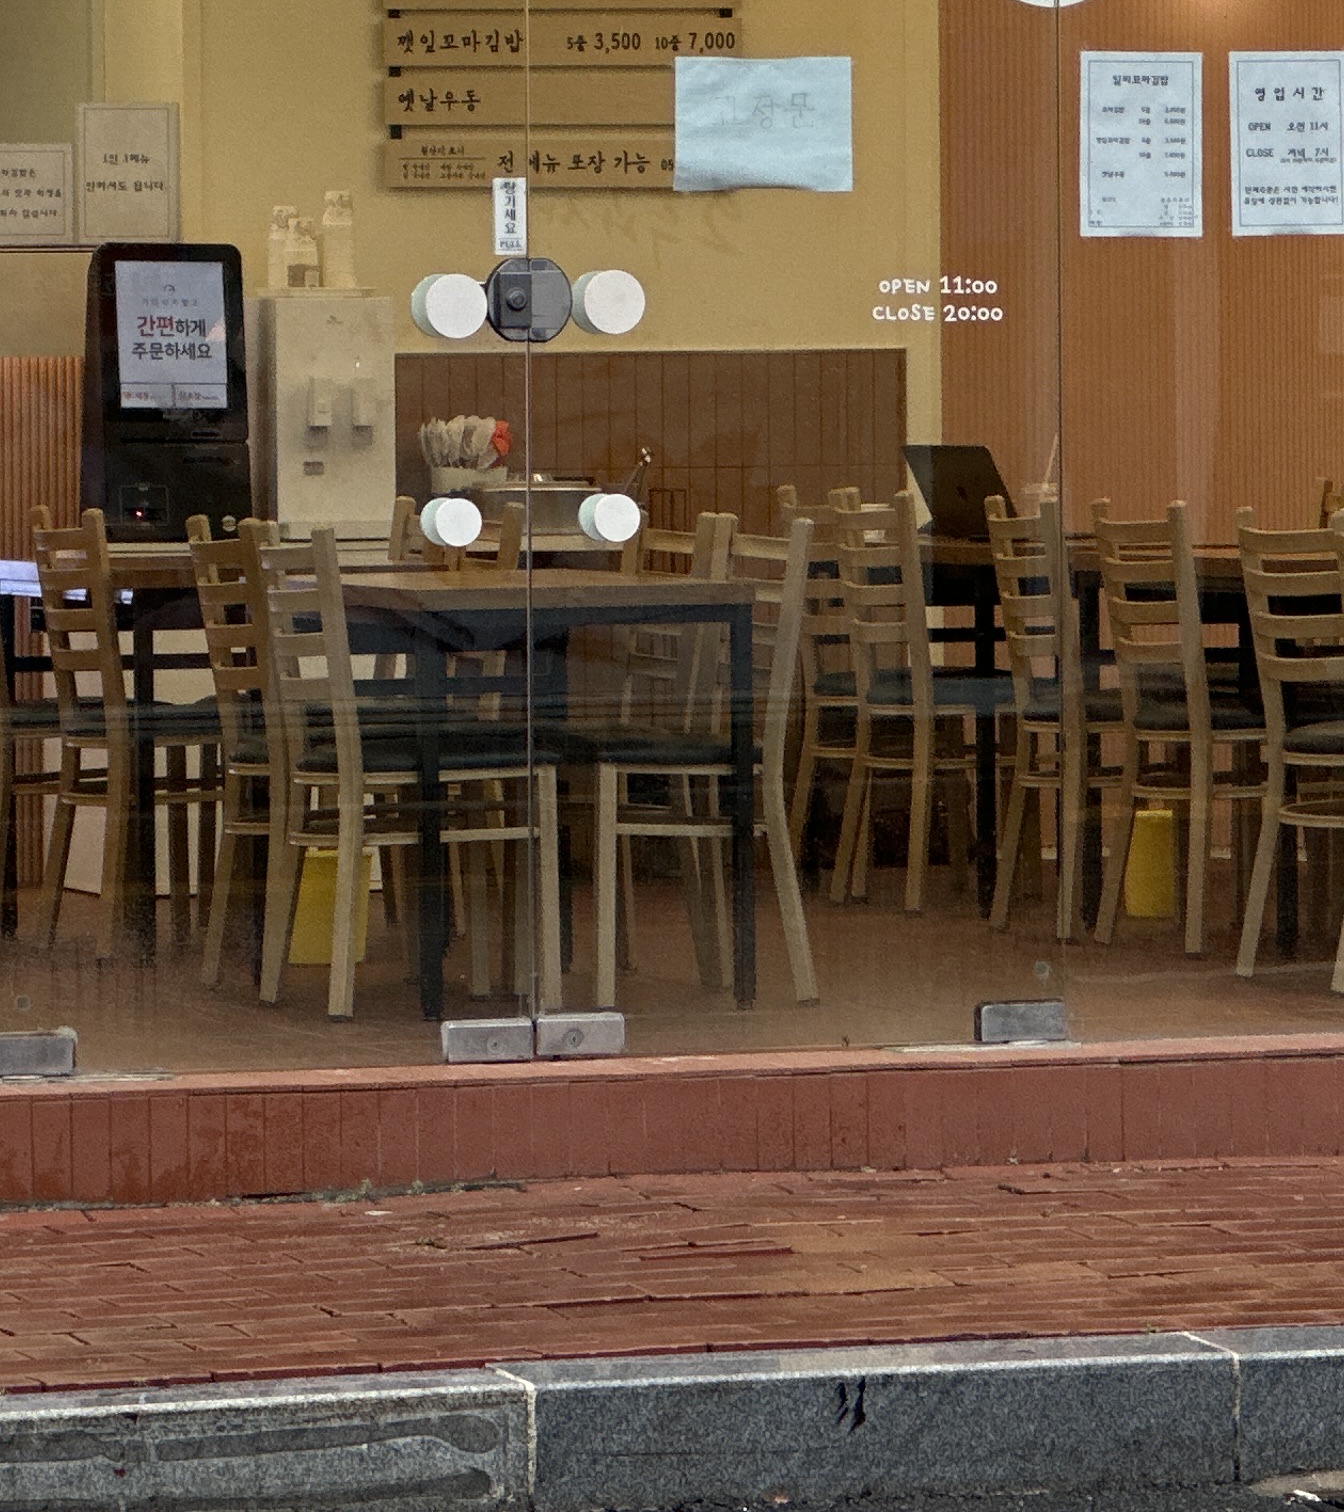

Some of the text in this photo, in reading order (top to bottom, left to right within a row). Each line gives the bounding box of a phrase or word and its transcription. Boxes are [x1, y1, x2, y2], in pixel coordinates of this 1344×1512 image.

[397, 29, 524, 53] 깻잎꼬마김밥
[594, 32, 642, 54] 3,500
[689, 32, 736, 54] 7,000
[398, 88, 481, 113] 옛날우동
[1254, 87, 1325, 102] 영업시간
[1247, 122, 1272, 131] OPEN
[497, 150, 514, 174] 전
[567, 150, 606, 174] 포장
[613, 150, 651, 174] 가능
[1245, 148, 1275, 158] CLOSE
[878, 275, 998, 294] OPEN 11:00
[872, 303, 1004, 322] CLOSE 20:00
[136, 314, 207, 337] 간편하게
[131, 342, 213, 361] 주문하세요
